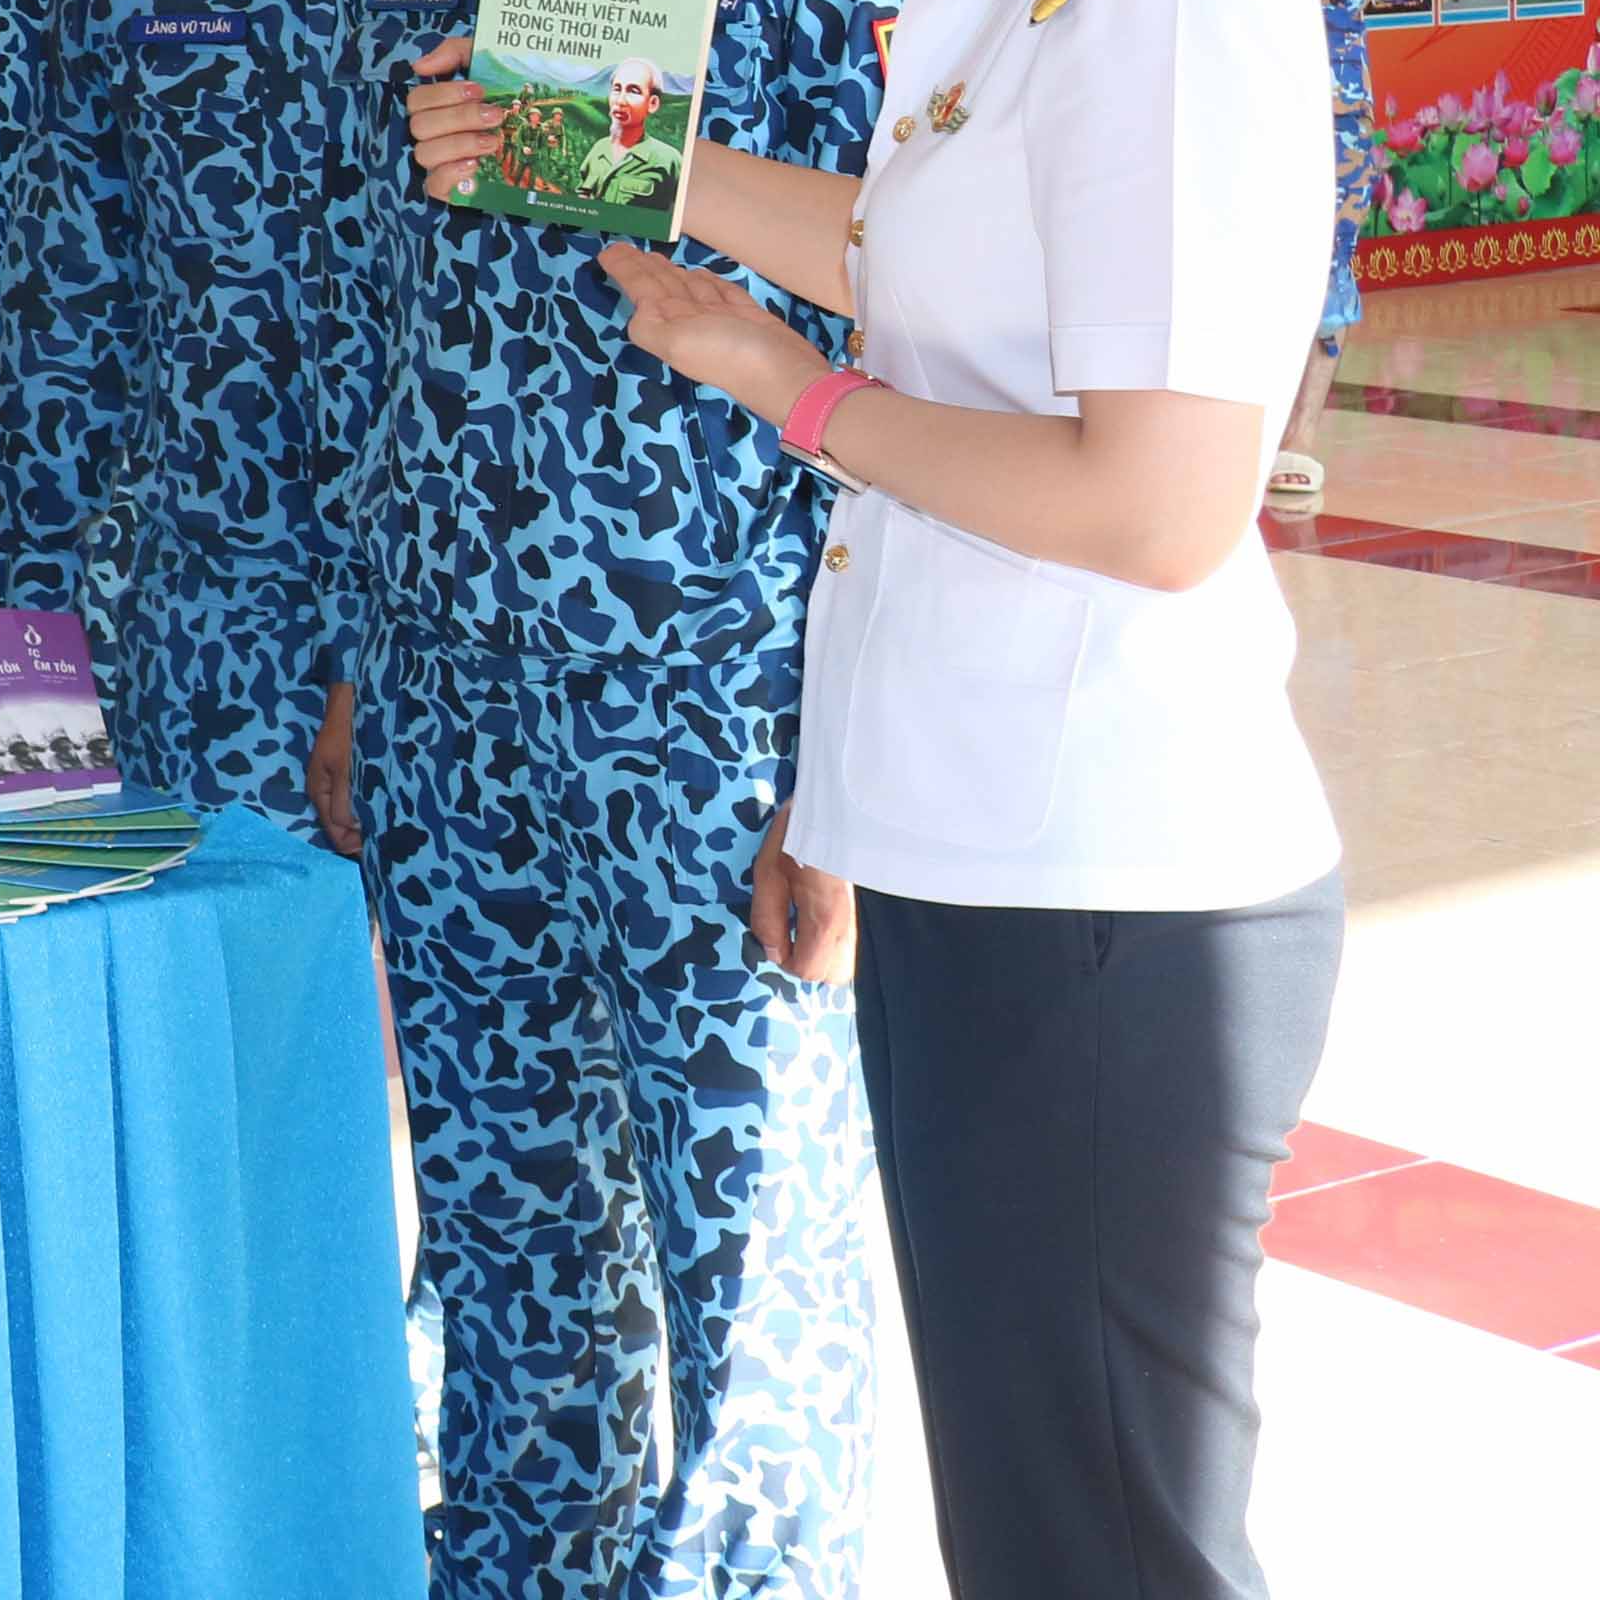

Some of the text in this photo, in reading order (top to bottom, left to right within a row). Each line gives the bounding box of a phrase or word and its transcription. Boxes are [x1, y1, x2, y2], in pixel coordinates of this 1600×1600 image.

[500, 10, 630, 45] TRONG THỜI ĐẠI
[592, 1, 626, 23] VIỆT
[630, 11, 668, 29] NAM
[497, 24, 602, 59] HỒ CHÍ MINH
